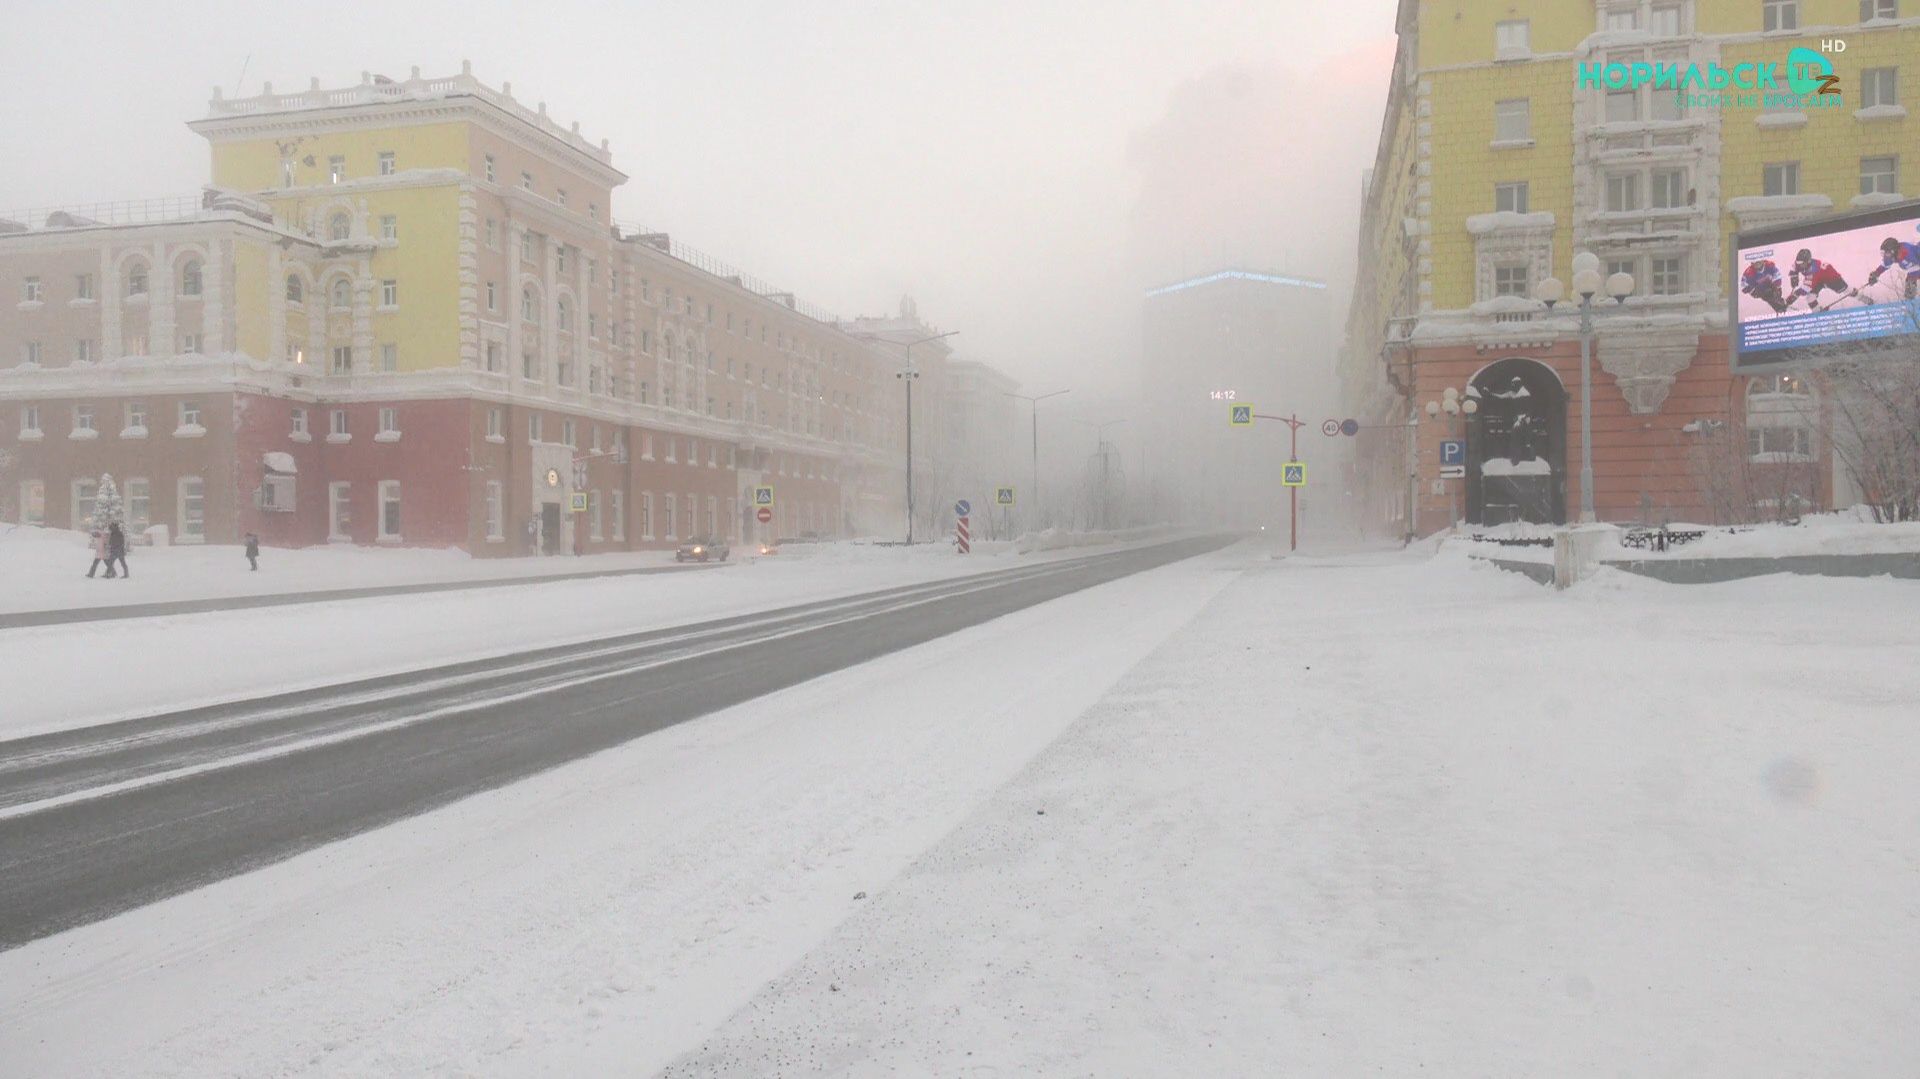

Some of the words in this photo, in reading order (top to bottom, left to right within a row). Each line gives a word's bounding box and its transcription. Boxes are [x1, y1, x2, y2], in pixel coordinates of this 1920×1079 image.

[1210, 390, 1236, 400] 14:12
[1325, 424, 1337, 433] 40
[1444, 442, 1459, 462] P
